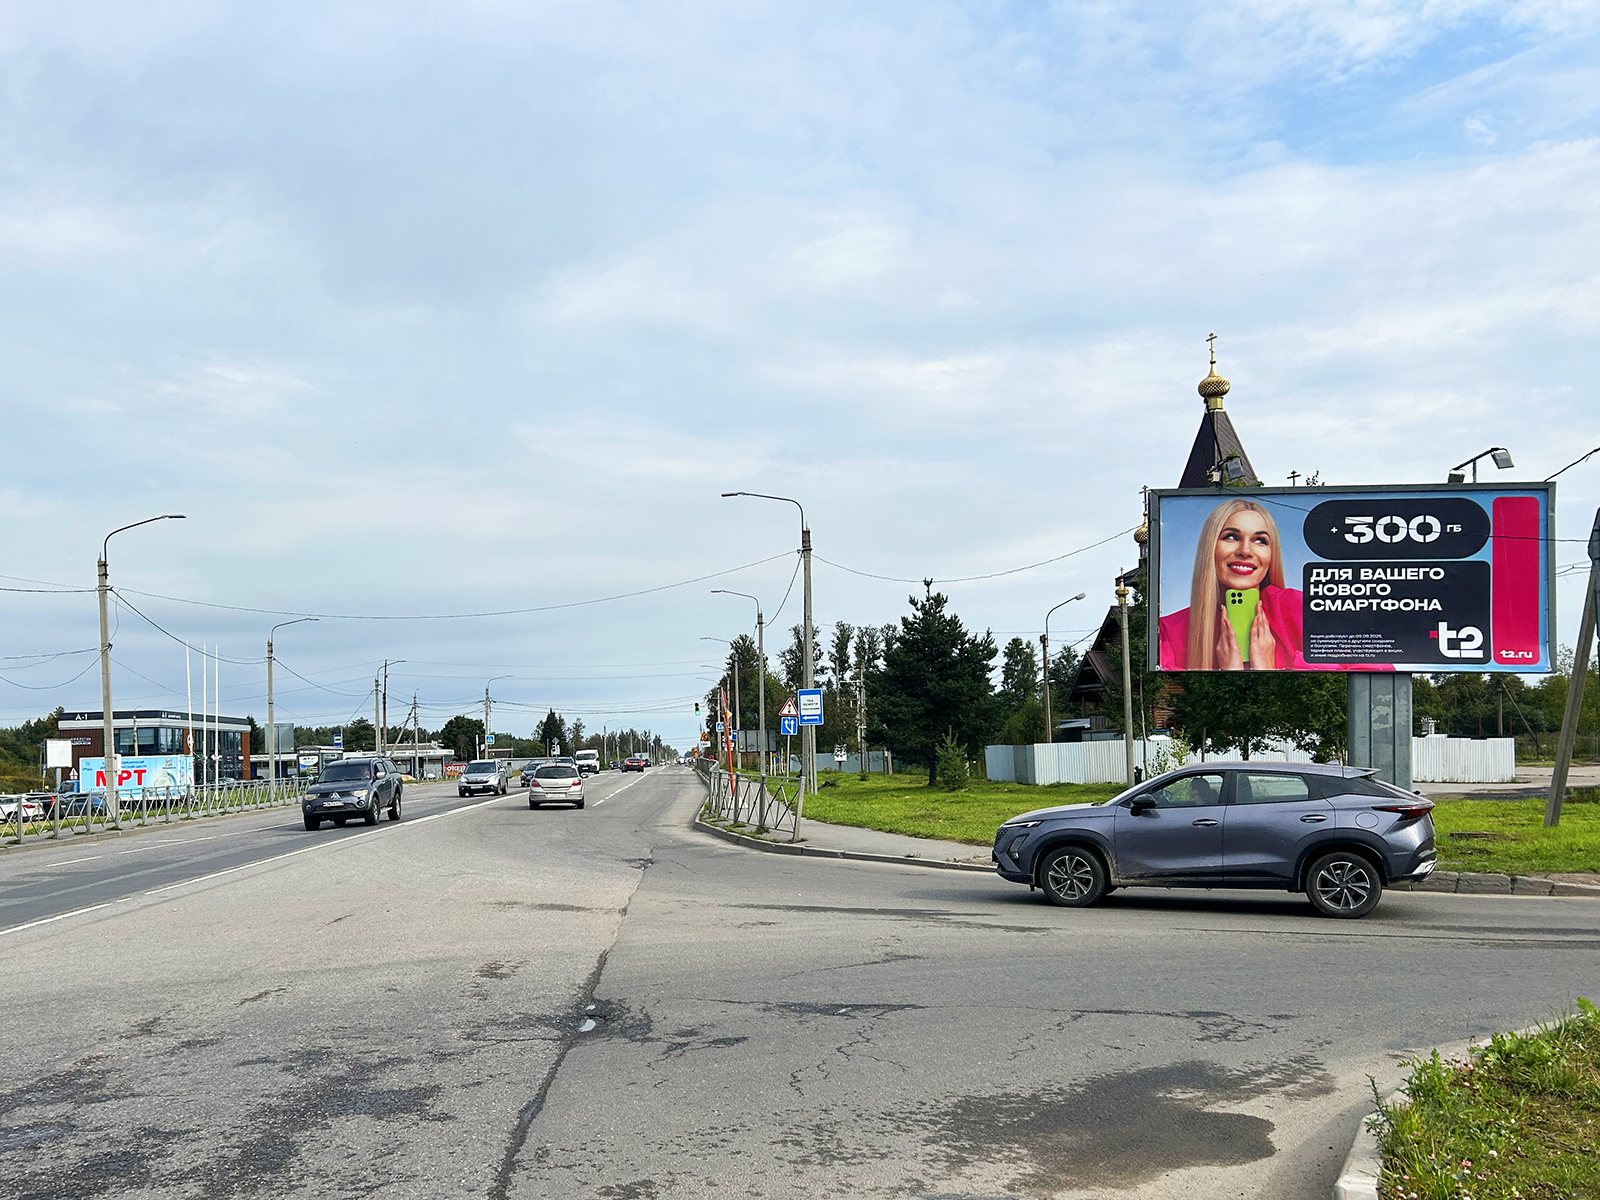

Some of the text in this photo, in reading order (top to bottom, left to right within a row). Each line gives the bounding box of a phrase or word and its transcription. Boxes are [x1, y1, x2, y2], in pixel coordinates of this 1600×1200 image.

[1344, 515, 1442, 544] 300
[1446, 524, 1462, 533] ГБ
[1310, 567, 1445, 583] ДЛЯ ВАШЕГО
[1310, 583, 1391, 596] НОВОГО
[1310, 599, 1442, 611] СМАРТФОНА
[1438, 621, 1484, 658] t2
[1500, 649, 1533, 658] t2.ru
